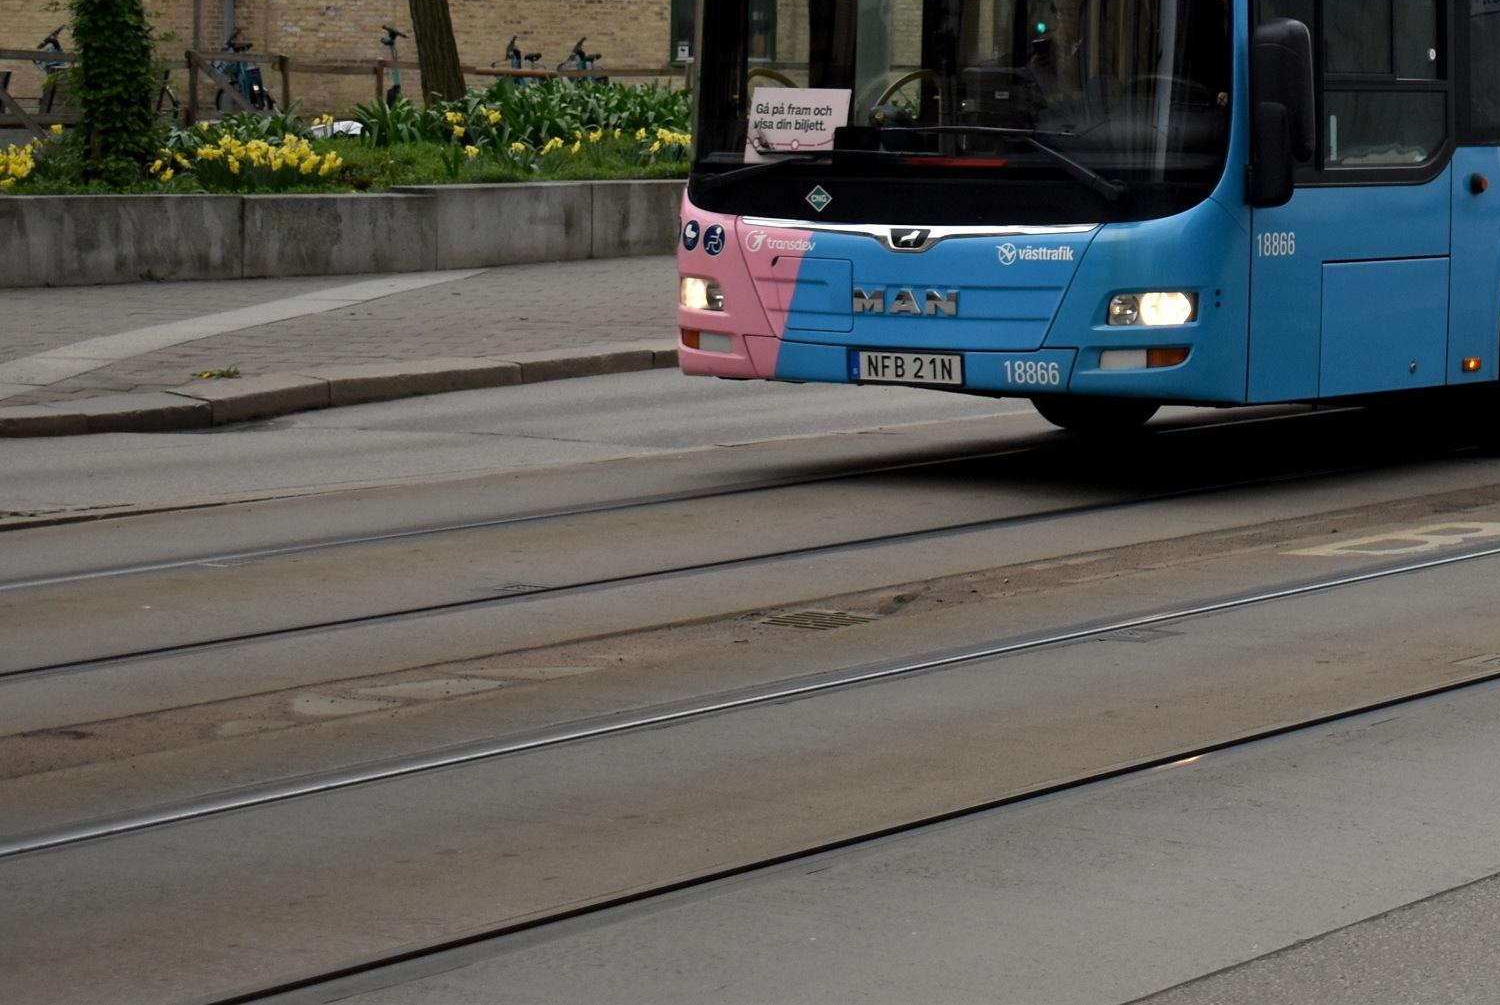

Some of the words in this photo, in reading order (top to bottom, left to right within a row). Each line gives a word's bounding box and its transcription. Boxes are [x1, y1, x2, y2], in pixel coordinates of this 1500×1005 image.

[756, 103, 769, 115] Gå
[772, 103, 784, 116] på
[788, 104, 811, 116] fram
[813, 105, 832, 117] och
[754, 118, 774, 130] visa
[776, 118, 792, 131] din
[794, 119, 826, 132] biljett.
[767, 237, 816, 251] transdev
[1019, 245, 1073, 261] västtrafik
[1256, 232, 1296, 257] 18866
[853, 287, 958, 316] MAN
[867, 355, 905, 378] NFB
[913, 357, 953, 381] 21N
[1003, 360, 1060, 385] 18866
